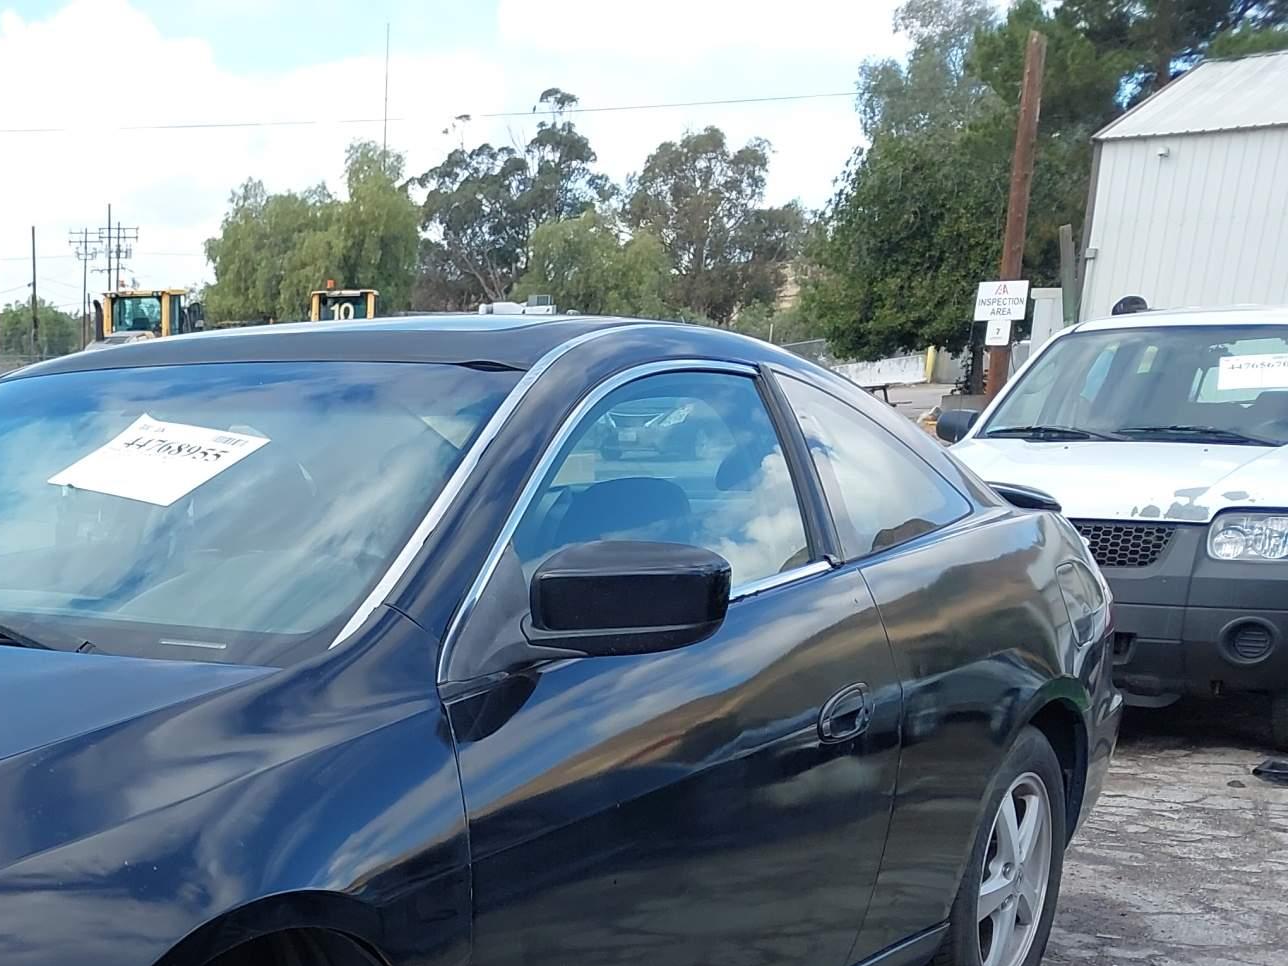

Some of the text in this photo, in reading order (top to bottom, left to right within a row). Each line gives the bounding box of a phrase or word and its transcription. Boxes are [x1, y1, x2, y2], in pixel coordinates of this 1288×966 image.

[978, 297, 1025, 306] INSPECTION
[330, 302, 355, 321] 10
[990, 307, 1012, 316] AREA
[123, 436, 230, 462] 44768955
